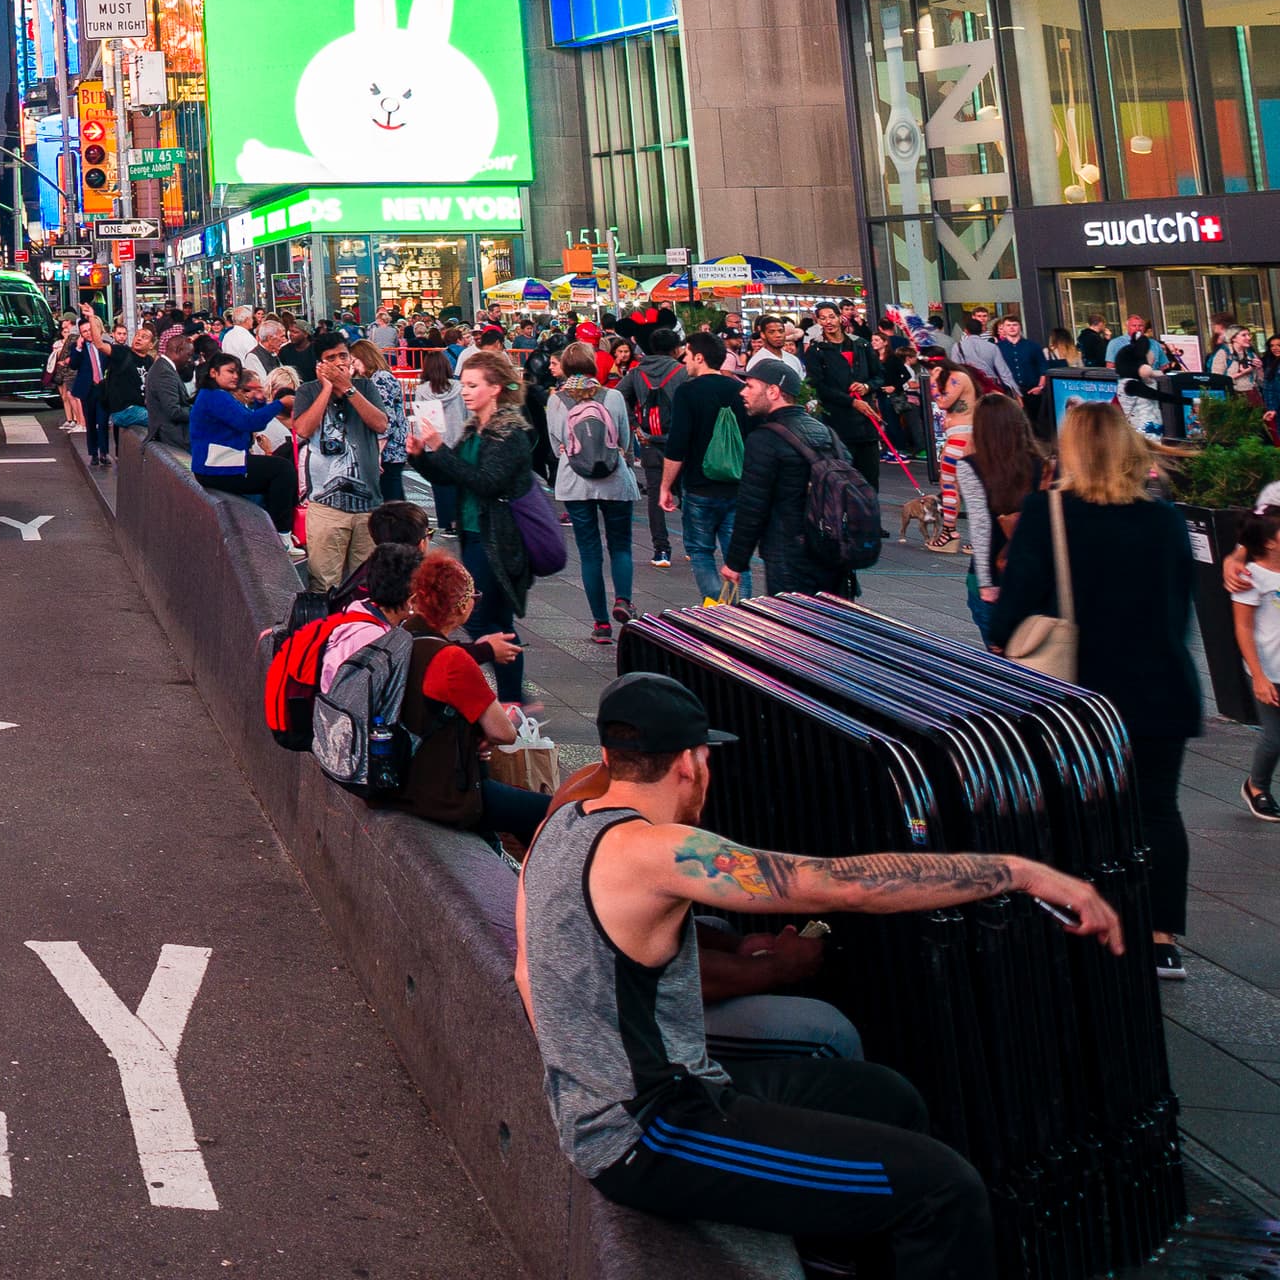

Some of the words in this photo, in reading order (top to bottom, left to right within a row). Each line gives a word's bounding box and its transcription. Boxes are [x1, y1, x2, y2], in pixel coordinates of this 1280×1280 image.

[99, 2, 132, 15] MUST
[88, 21, 113, 31] TURN
[118, 20, 145, 30] RIGHT
[144, 151, 154, 163] W
[159, 150, 172, 162] 45
[176, 150, 184, 158] St
[129, 165, 150, 177] George
[152, 163, 171, 172] Abbott
[382, 197, 452, 221] NEW
[104, 225, 122, 234] ONE
[131, 224, 149, 233] WAY
[1084, 211, 1201, 247] swatch
